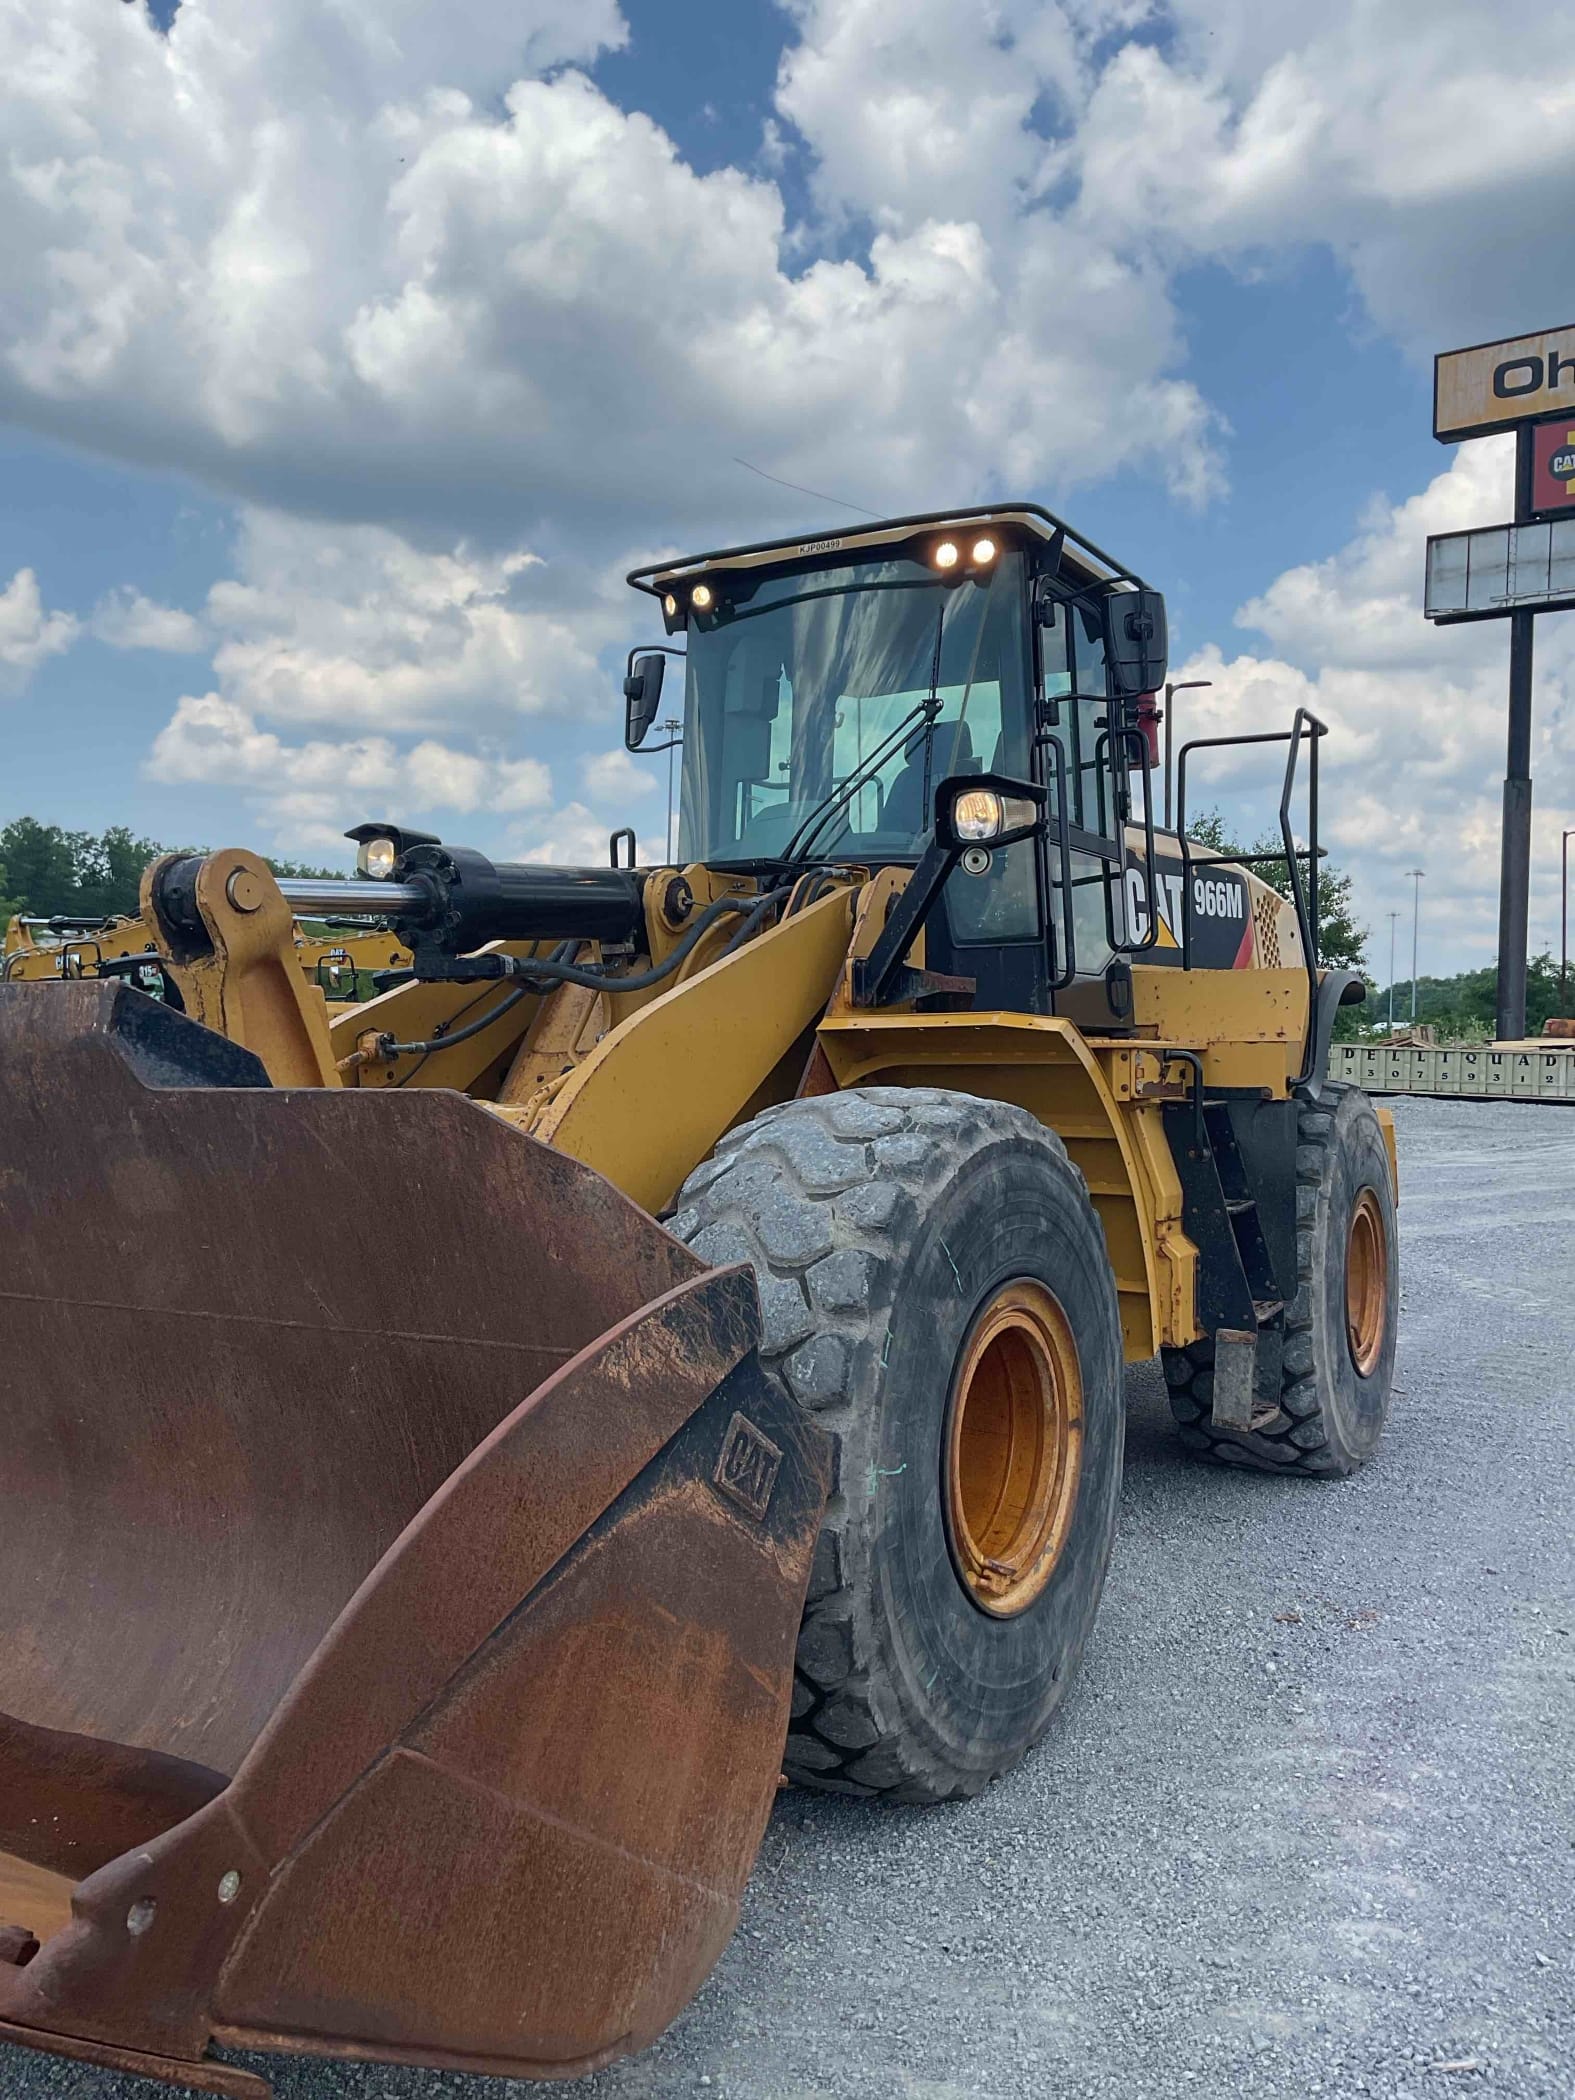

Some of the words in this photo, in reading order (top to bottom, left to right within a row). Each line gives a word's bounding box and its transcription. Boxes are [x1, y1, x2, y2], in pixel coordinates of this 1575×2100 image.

[800, 540, 840, 553] KJP00499
[1194, 879, 1242, 918] 966M
[1345, 1048, 1575, 1067] DELLIQUAD
[725, 1431, 777, 1505] CAT
